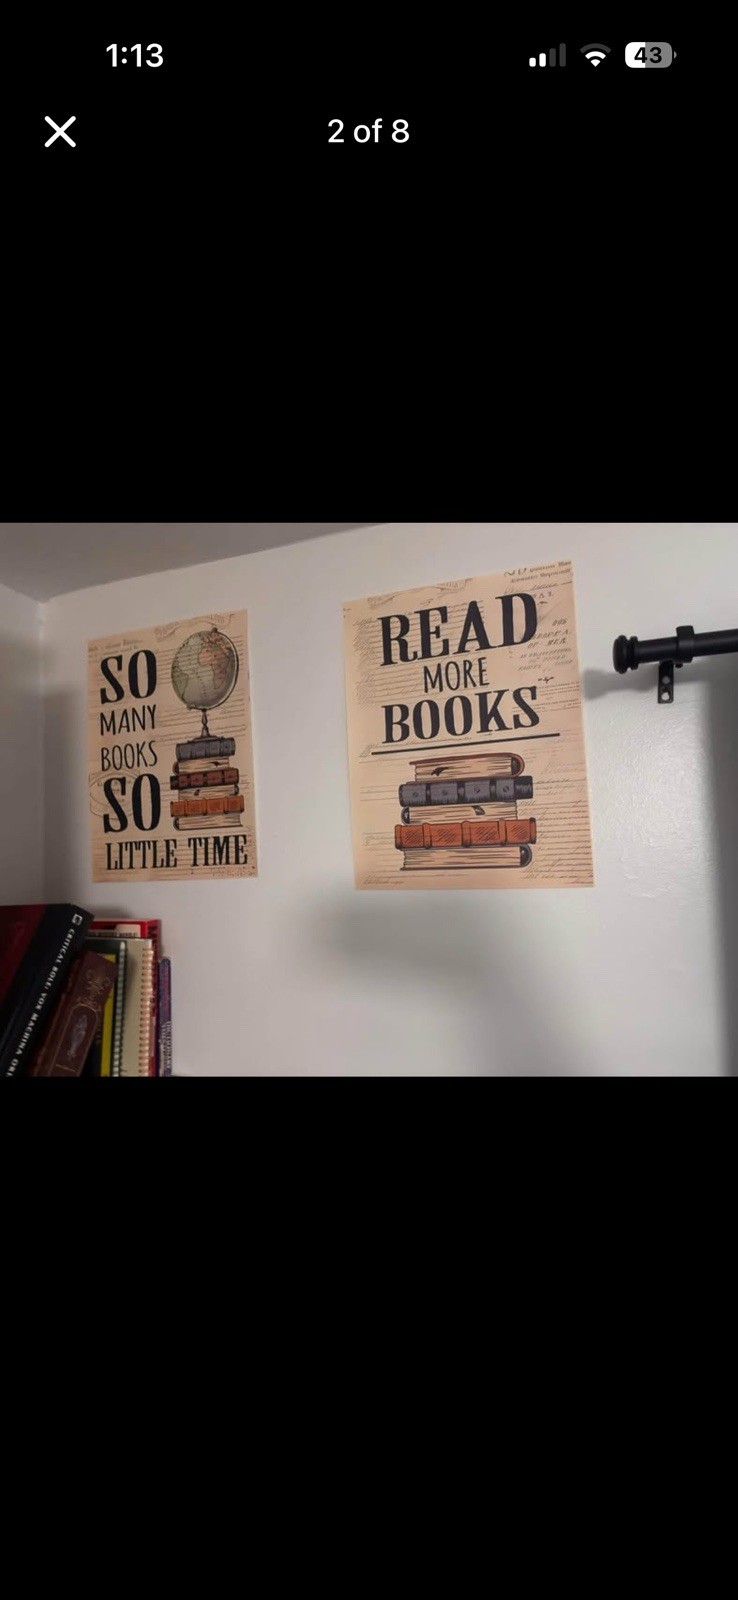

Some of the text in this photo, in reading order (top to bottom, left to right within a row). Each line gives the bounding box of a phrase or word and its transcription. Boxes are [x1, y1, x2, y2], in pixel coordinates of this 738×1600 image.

[378, 593, 538, 666] READ
[100, 649, 157, 704] SO
[423, 657, 490, 693] MORE
[100, 704, 157, 736] MANY
[381, 686, 540, 744] BOOKS
[101, 740, 158, 772] BOOKS
[103, 773, 161, 834] SO
[105, 834, 248, 871] LITTLE TIME
[55, 928, 75, 963] CRITICAL
[35, 992, 47, 1010] VOX
[15, 1012, 39, 1055] MACHINA
[5, 1058, 19, 1077] ORI
